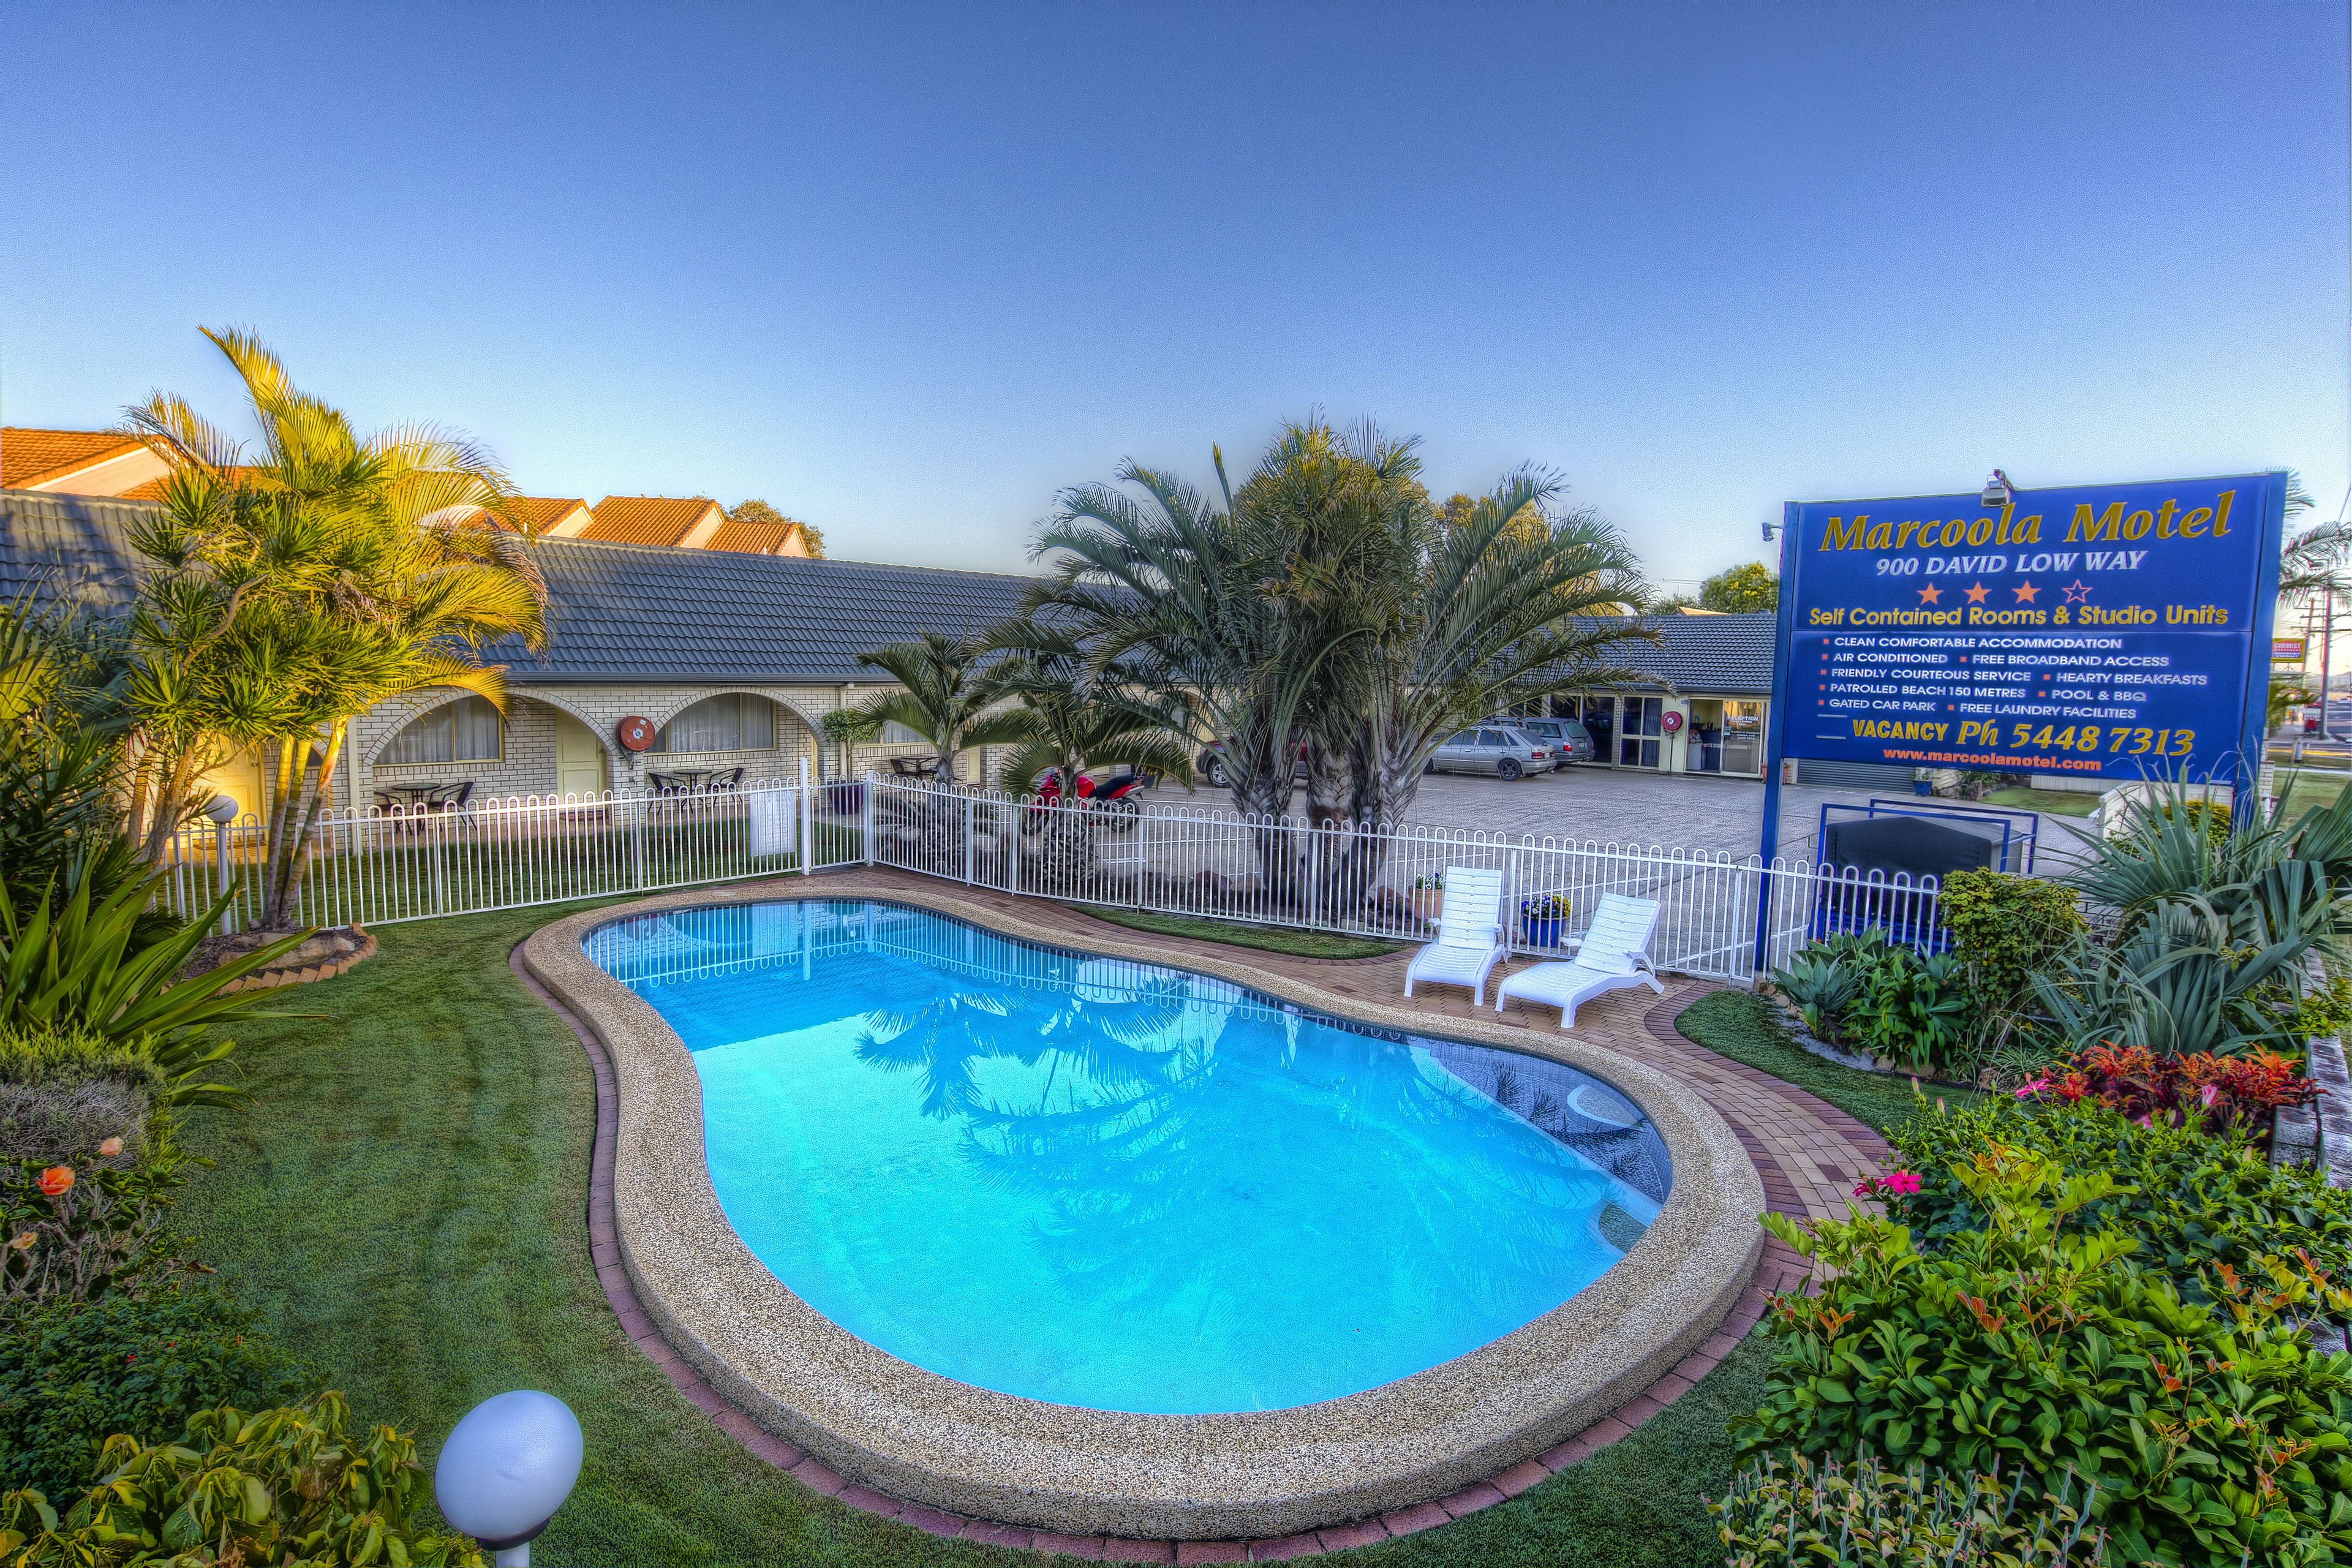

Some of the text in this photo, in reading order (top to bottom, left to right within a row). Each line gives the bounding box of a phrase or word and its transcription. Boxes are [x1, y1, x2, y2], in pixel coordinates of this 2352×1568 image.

[1817, 489, 2236, 551] Marcoola Motel
[1876, 550, 2149, 576] 900 DAVID LOW WAY
[1809, 605, 2228, 625] Self Contained Rooms & Studio Units
[1834, 637, 2123, 649] CLEAN COMFORTABLE ACCOMMODATION
[1833, 653, 1948, 663] AIR CONDITIONED
[1972, 655, 2170, 667] FREE BROADBAND ACCESS
[1831, 668, 2032, 681] FRIENDLY COURTEOUS SERVICE
[2056, 673, 2209, 685] HEARTY BREAKFASTS
[1830, 684, 2026, 698] PATROLLED BEACH 150 METRES
[2051, 690, 2147, 701] POOL & BBQ
[1829, 699, 1937, 711] GATED CAR PARK
[1959, 703, 2138, 718] FREE LAUNDRY FACILITIES
[1852, 718, 2196, 756] VACANCY Ph 5448 7313
[1883, 748, 2102, 771] www.marcoolamotel.com
